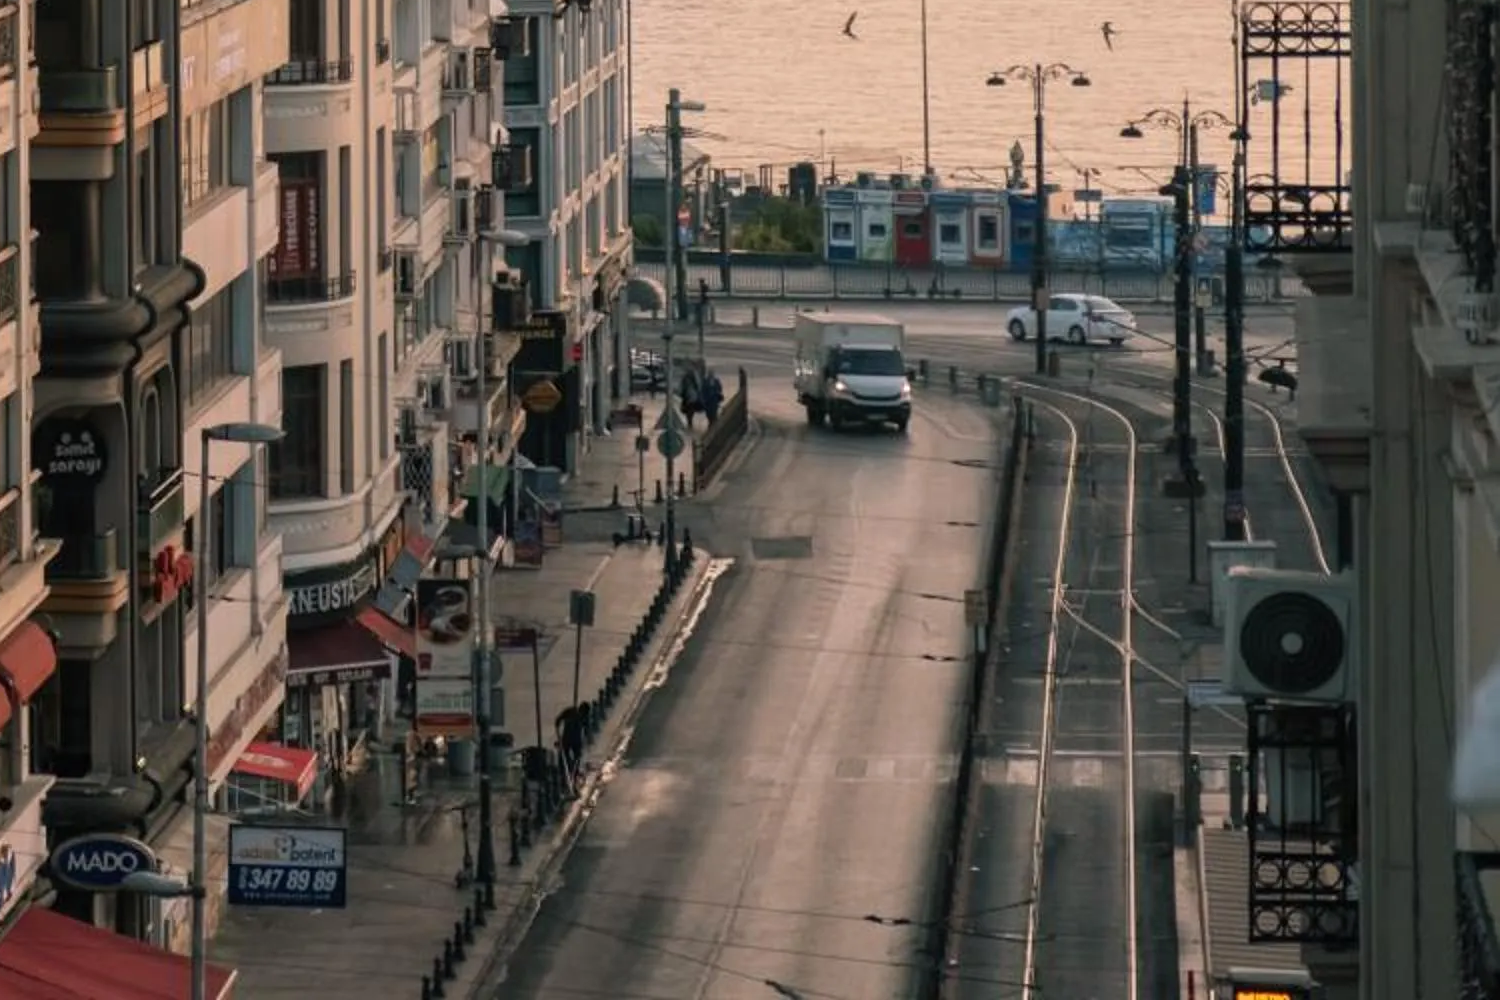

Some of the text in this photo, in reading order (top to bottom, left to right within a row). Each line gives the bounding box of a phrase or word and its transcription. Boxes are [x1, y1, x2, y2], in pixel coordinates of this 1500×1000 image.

[68, 851, 138, 873] MADO
[290, 847, 336, 862] patent
[248, 867, 285, 890] 347
[286, 869, 311, 891] 89
[312, 869, 338, 892] 89
